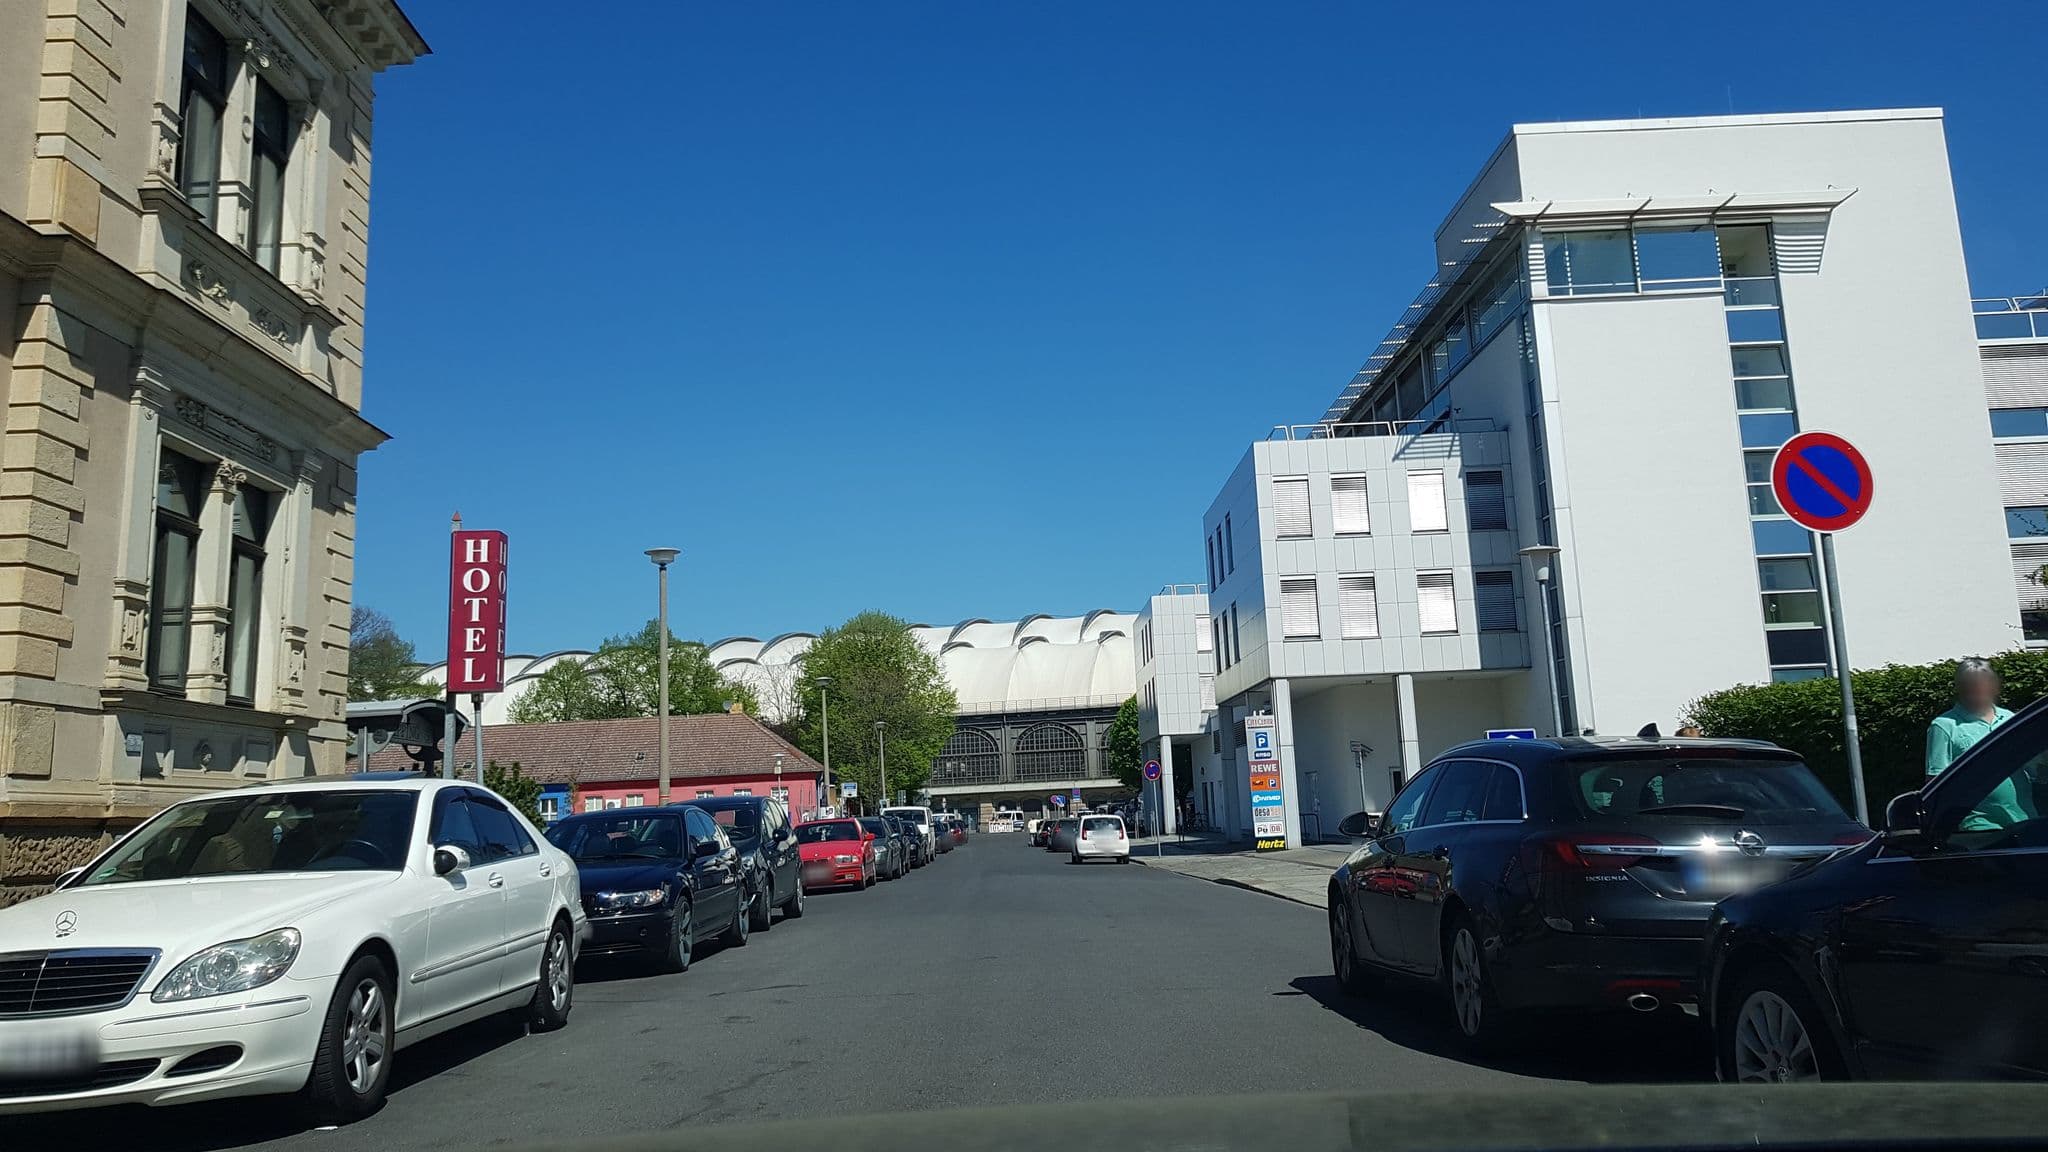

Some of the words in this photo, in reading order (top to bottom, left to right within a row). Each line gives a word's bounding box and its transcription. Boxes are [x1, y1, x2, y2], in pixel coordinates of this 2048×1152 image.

[463, 539, 490, 683] HOTEL
[1250, 764, 1278, 773] REWE
[1257, 839, 1285, 849] Hertz
